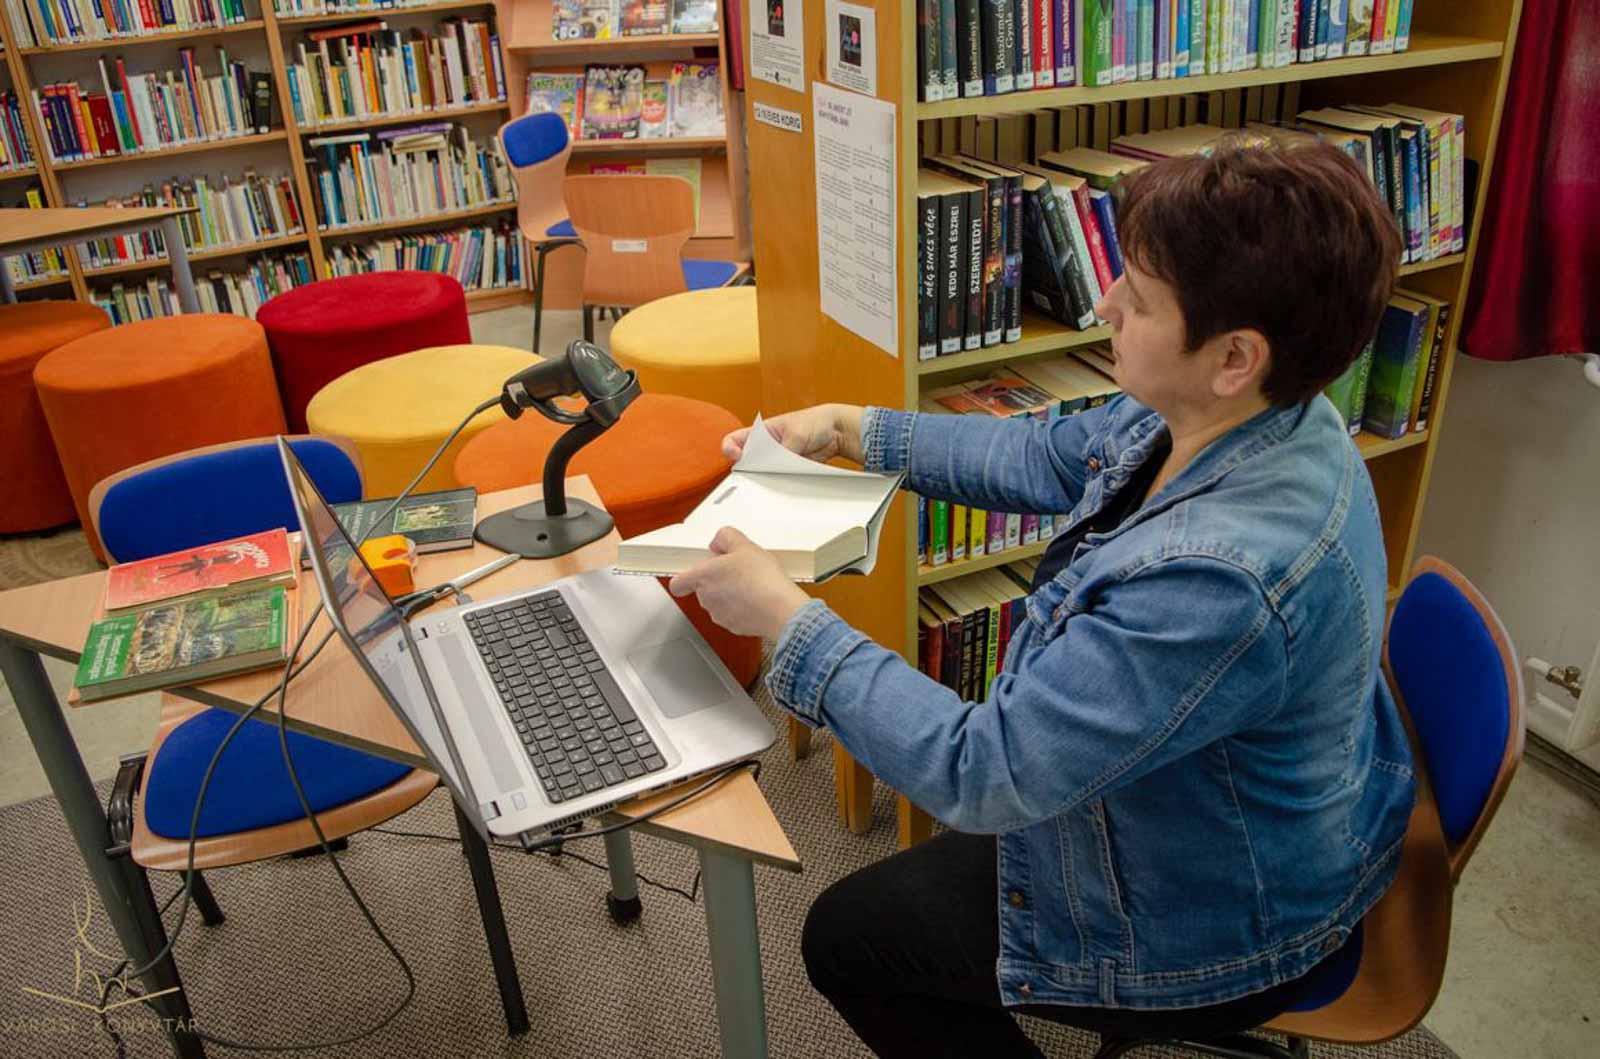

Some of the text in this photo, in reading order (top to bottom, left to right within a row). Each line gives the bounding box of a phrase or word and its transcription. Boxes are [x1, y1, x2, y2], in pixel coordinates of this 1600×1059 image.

[1004, 12, 1014, 49] Gyula
[925, 239, 936, 270] SINCS
[948, 205, 960, 299] VEDD MÁR ÉSZRE!
[924, 270, 936, 298] MÉG
